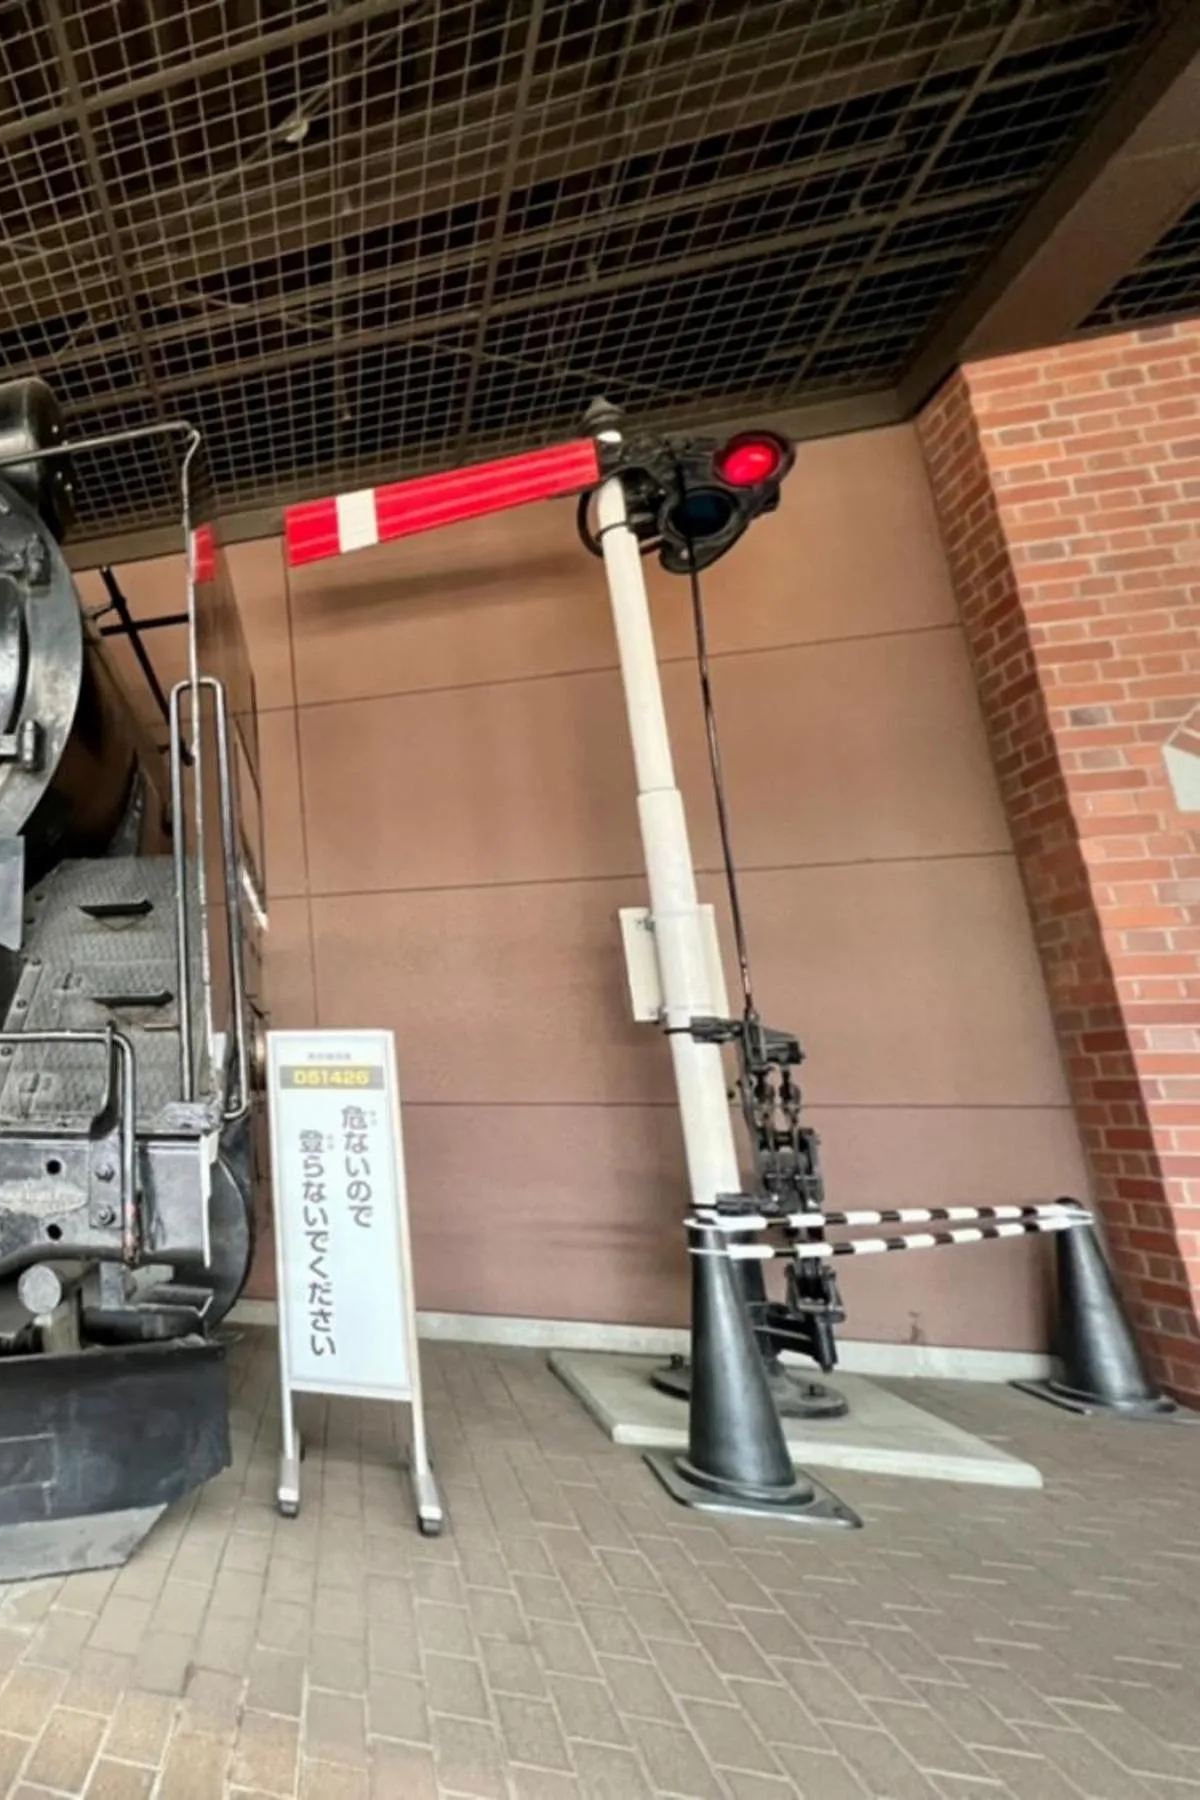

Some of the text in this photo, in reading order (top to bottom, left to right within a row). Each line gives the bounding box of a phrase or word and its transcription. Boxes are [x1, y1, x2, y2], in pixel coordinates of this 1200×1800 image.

[299, 1131, 337, 1356] 登らないでください
[341, 1106, 374, 1228] 危ないので
